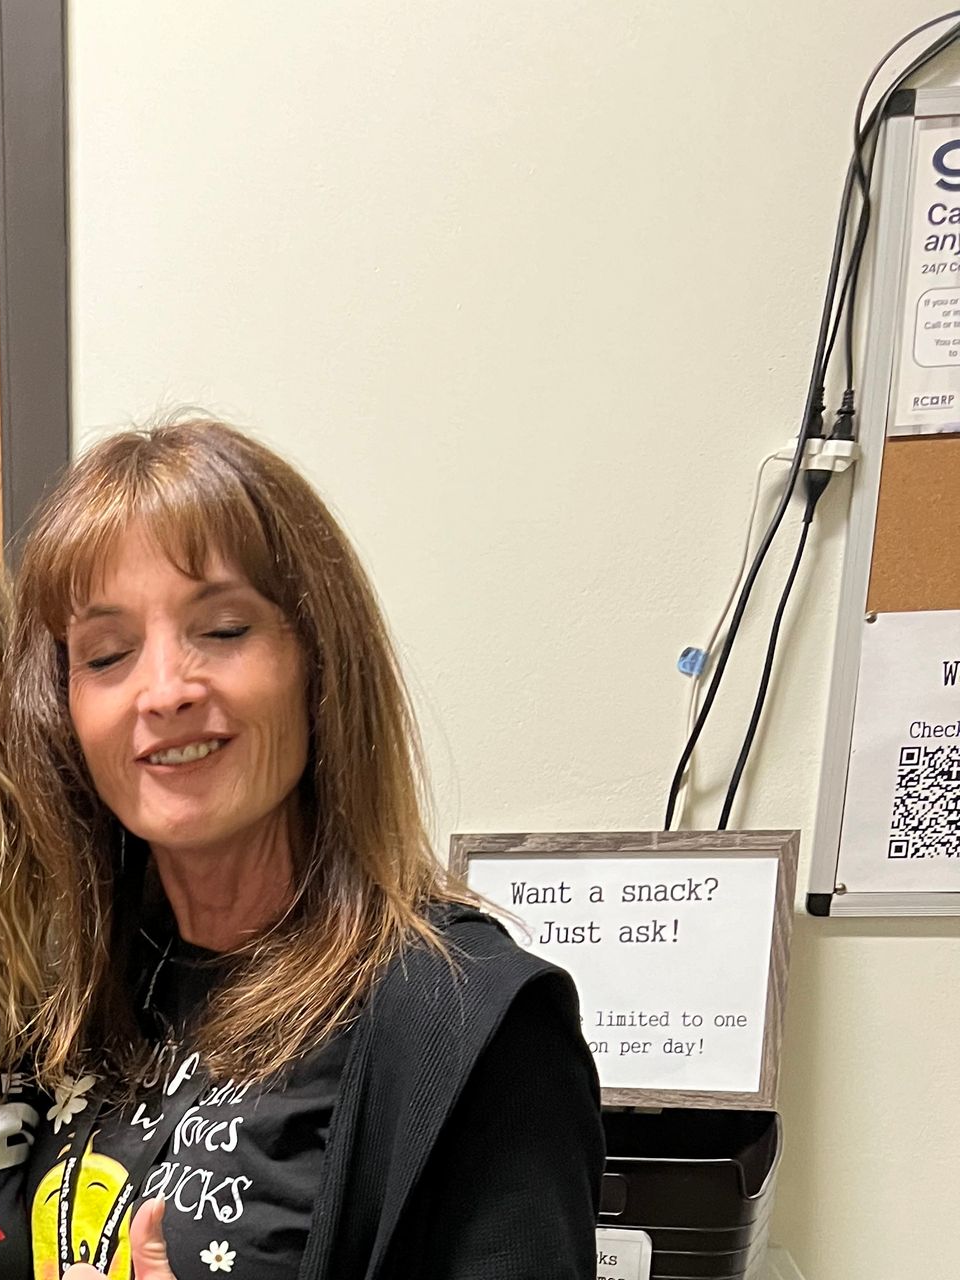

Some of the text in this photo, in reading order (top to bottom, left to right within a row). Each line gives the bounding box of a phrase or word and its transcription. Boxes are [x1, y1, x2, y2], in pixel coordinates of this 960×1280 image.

[511, 878, 719, 905] Want a snack?
[539, 919, 680, 945] Just ask!
[596, 1011, 670, 1027] limited
[682, 1013, 703, 1027] to
[714, 1014, 747, 1027] one
[620, 1041, 652, 1056] per
[663, 1039, 705, 1057] day!
[142, 1162, 253, 1223] DUCKS
[596, 1251, 618, 1266] ks
